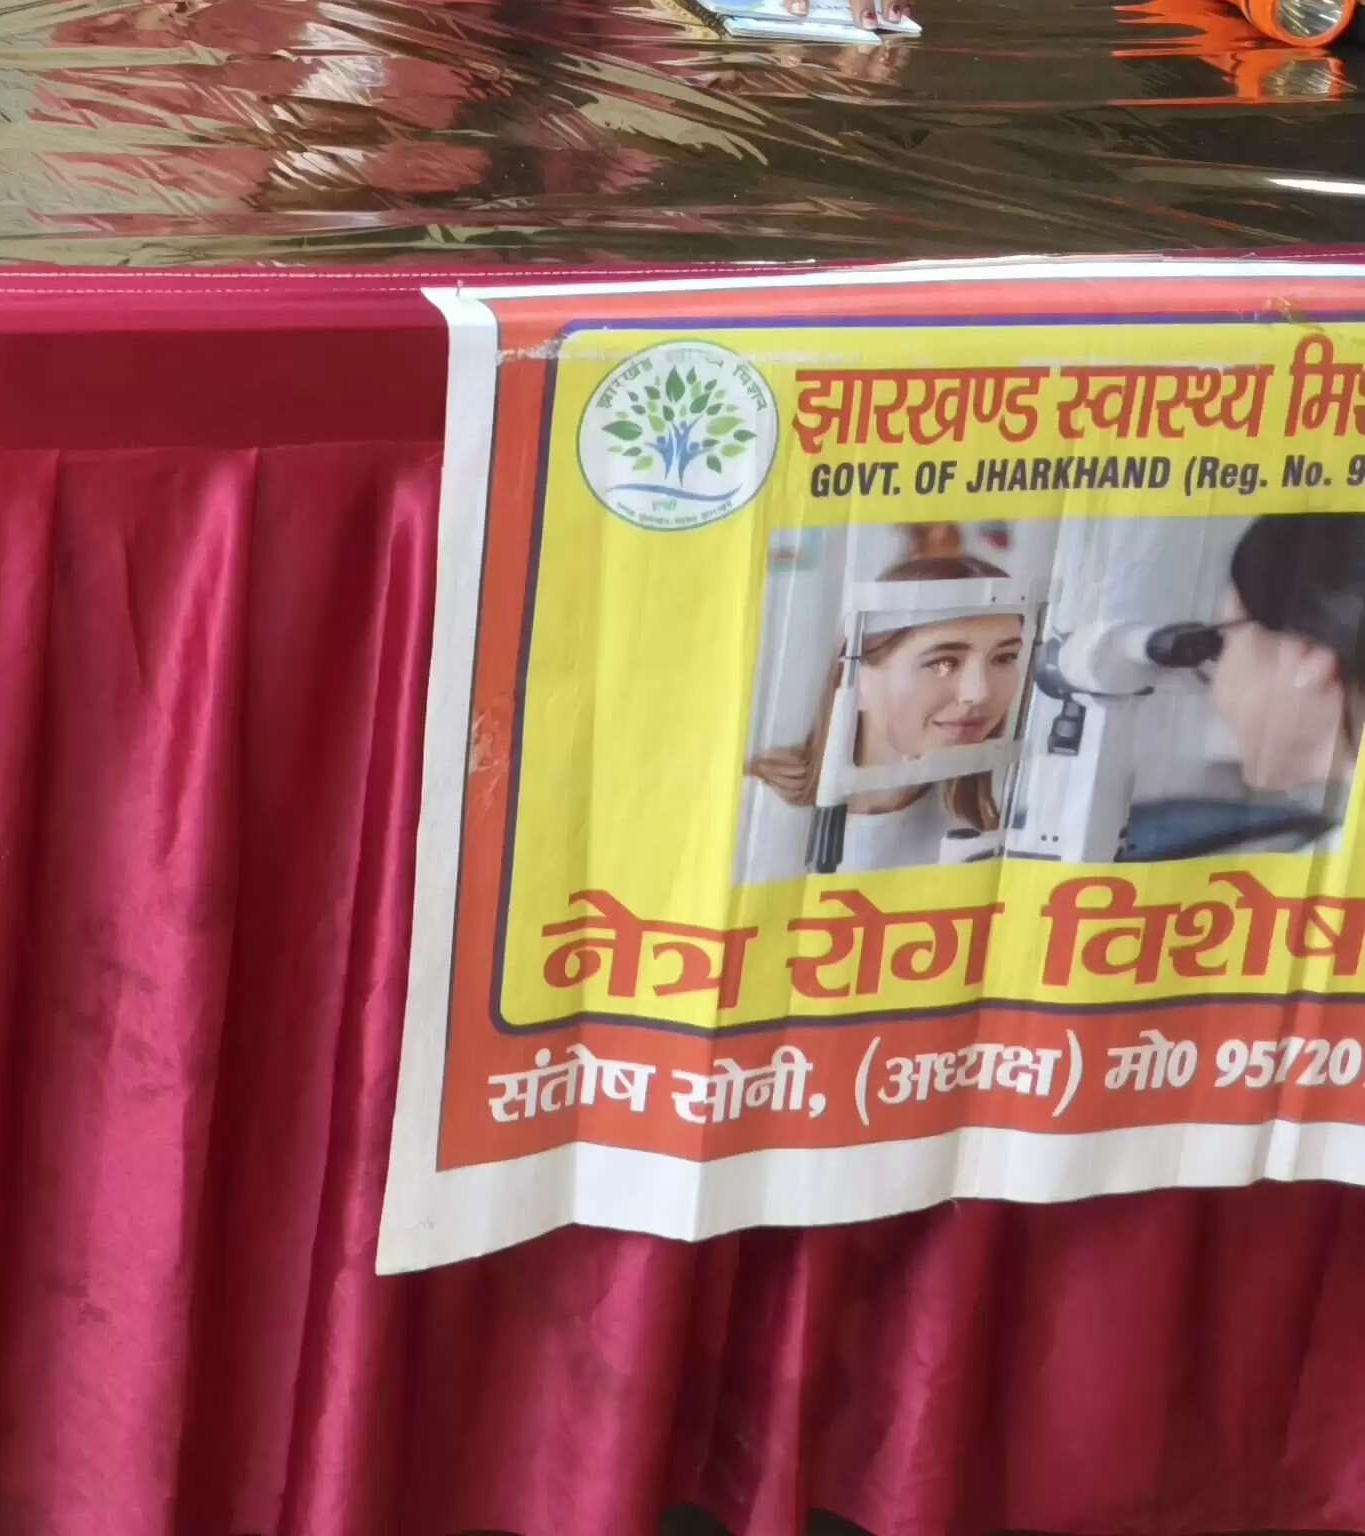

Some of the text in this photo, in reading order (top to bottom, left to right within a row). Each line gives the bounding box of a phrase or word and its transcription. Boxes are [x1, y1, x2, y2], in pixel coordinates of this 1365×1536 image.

[791, 364, 1051, 454] झारखण्ड
[1057, 363, 1275, 446] स्वास्थ्य
[810, 461, 899, 498] GOVT.
[915, 460, 956, 495] OF
[966, 455, 1171, 493] JHARKHAND
[1184, 455, 1268, 497] (Reg.
[1282, 455, 1332, 487] No.
[541, 889, 757, 1010] नेत्र
[786, 889, 1004, 998] रोग
[488, 1043, 656, 1124] संतोष
[671, 1045, 827, 1125] सोनी,
[853, 1029, 1083, 1125] (अध्यक्ष)
